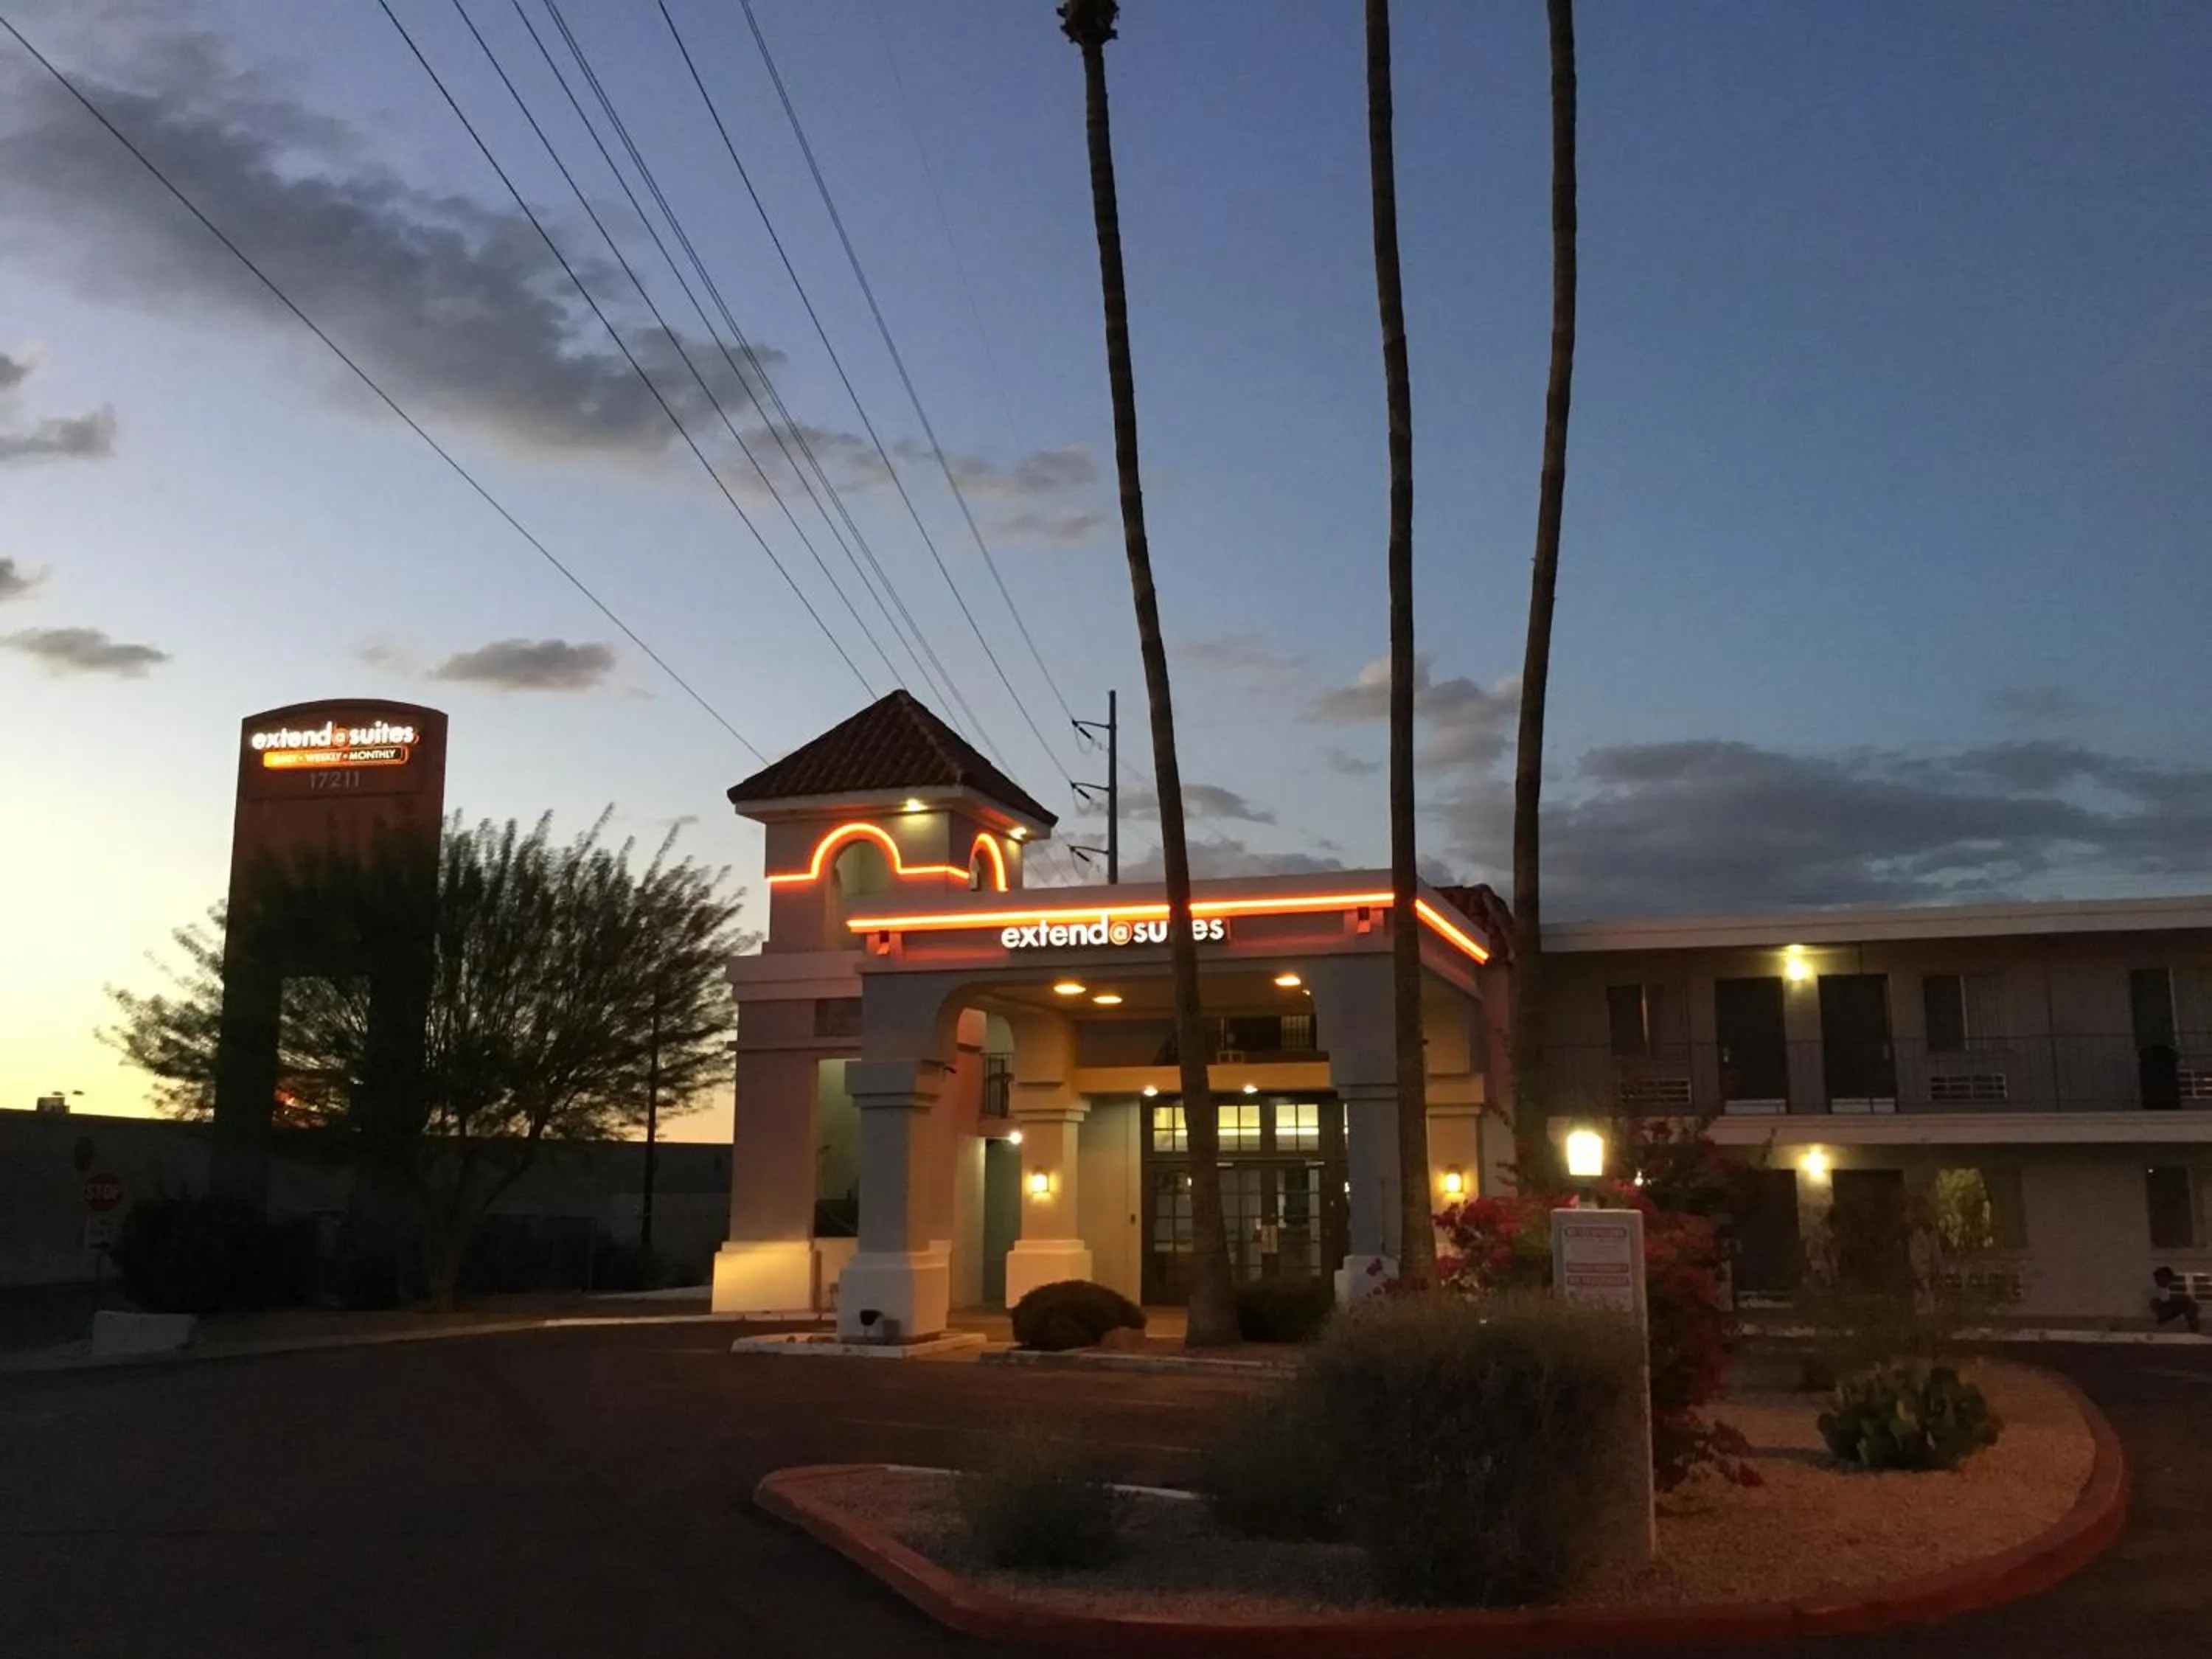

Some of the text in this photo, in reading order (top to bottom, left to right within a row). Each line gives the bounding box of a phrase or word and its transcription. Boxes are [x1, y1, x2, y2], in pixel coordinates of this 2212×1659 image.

[349, 749, 396, 761] MONTHLY
[310, 771, 360, 789] 17211
[85, 1183, 122, 1202] STOP
